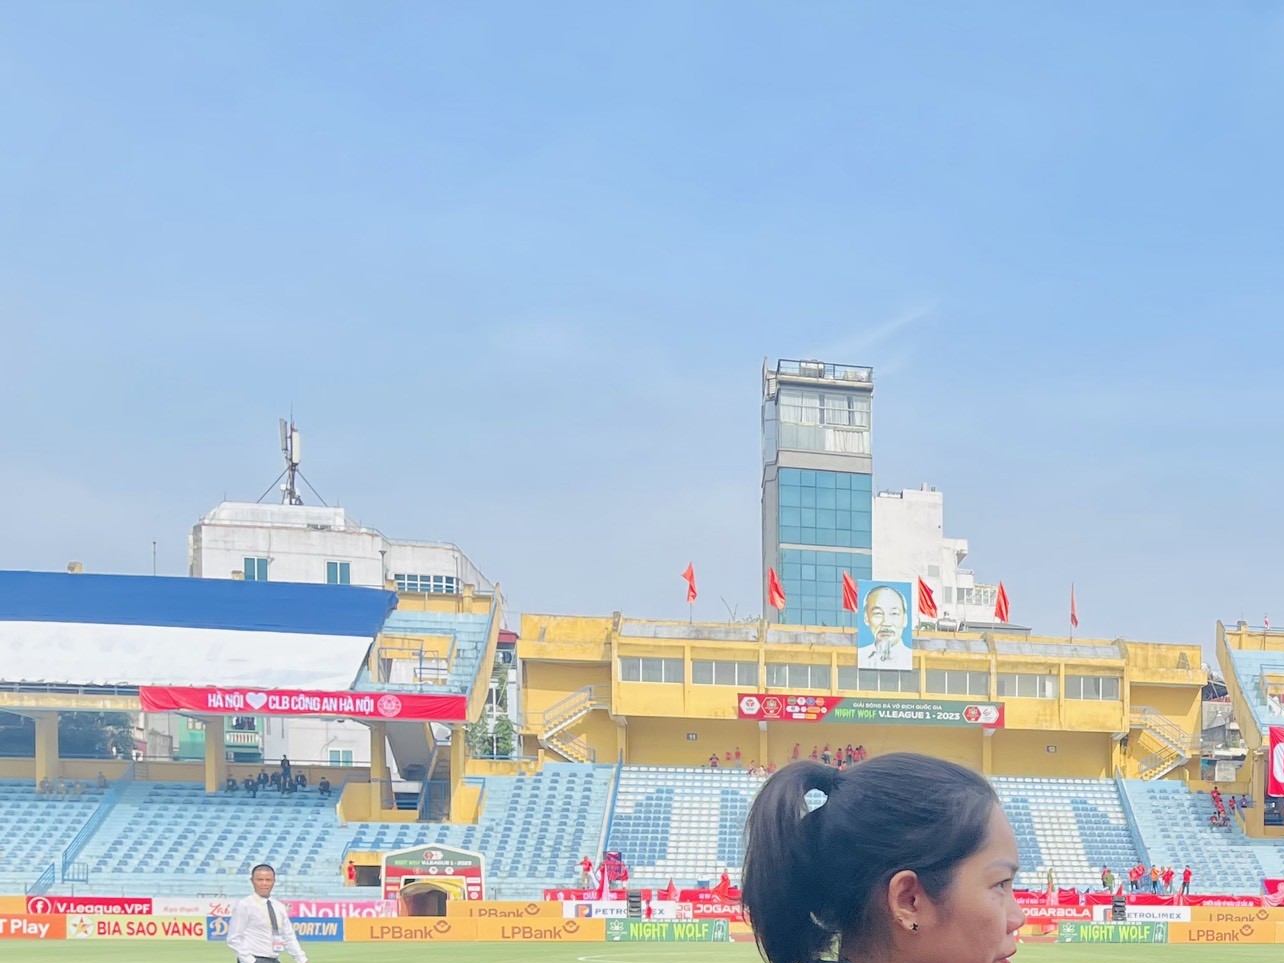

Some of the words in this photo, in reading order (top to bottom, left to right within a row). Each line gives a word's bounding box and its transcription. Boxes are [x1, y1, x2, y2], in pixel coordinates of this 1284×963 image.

[208, 691, 224, 708] HÀ
[225, 692, 244, 711] NỘI
[268, 695, 290, 709] CLB
[291, 694, 320, 711] CÔNG
[322, 697, 338, 711] AN
[340, 696, 354, 711] HÀ
[356, 696, 374, 715] NỘI
[834, 708, 855, 718] NIGHT
[857, 709, 876, 719] WOLF
[878, 711, 924, 719] V.LEAGUE
[936, 712, 960, 720] 2023
[694, 903, 749, 914] JOGAR
[1022, 907, 1091, 917] OGARBOLA
[10, 919, 50, 938] Play
[97, 921, 122, 936] BIA
[126, 921, 157, 936] SAO
[162, 917, 203, 937] VÀNG
[370, 926, 433, 939] LPBank
[501, 926, 562, 939] LPBank
[630, 923, 668, 939] NIGHT
[674, 923, 709, 939] WOLF
[1080, 925, 1114, 941] NIGHT
[1119, 925, 1150, 941] WOLF
[1188, 930, 1239, 941] LPBank
